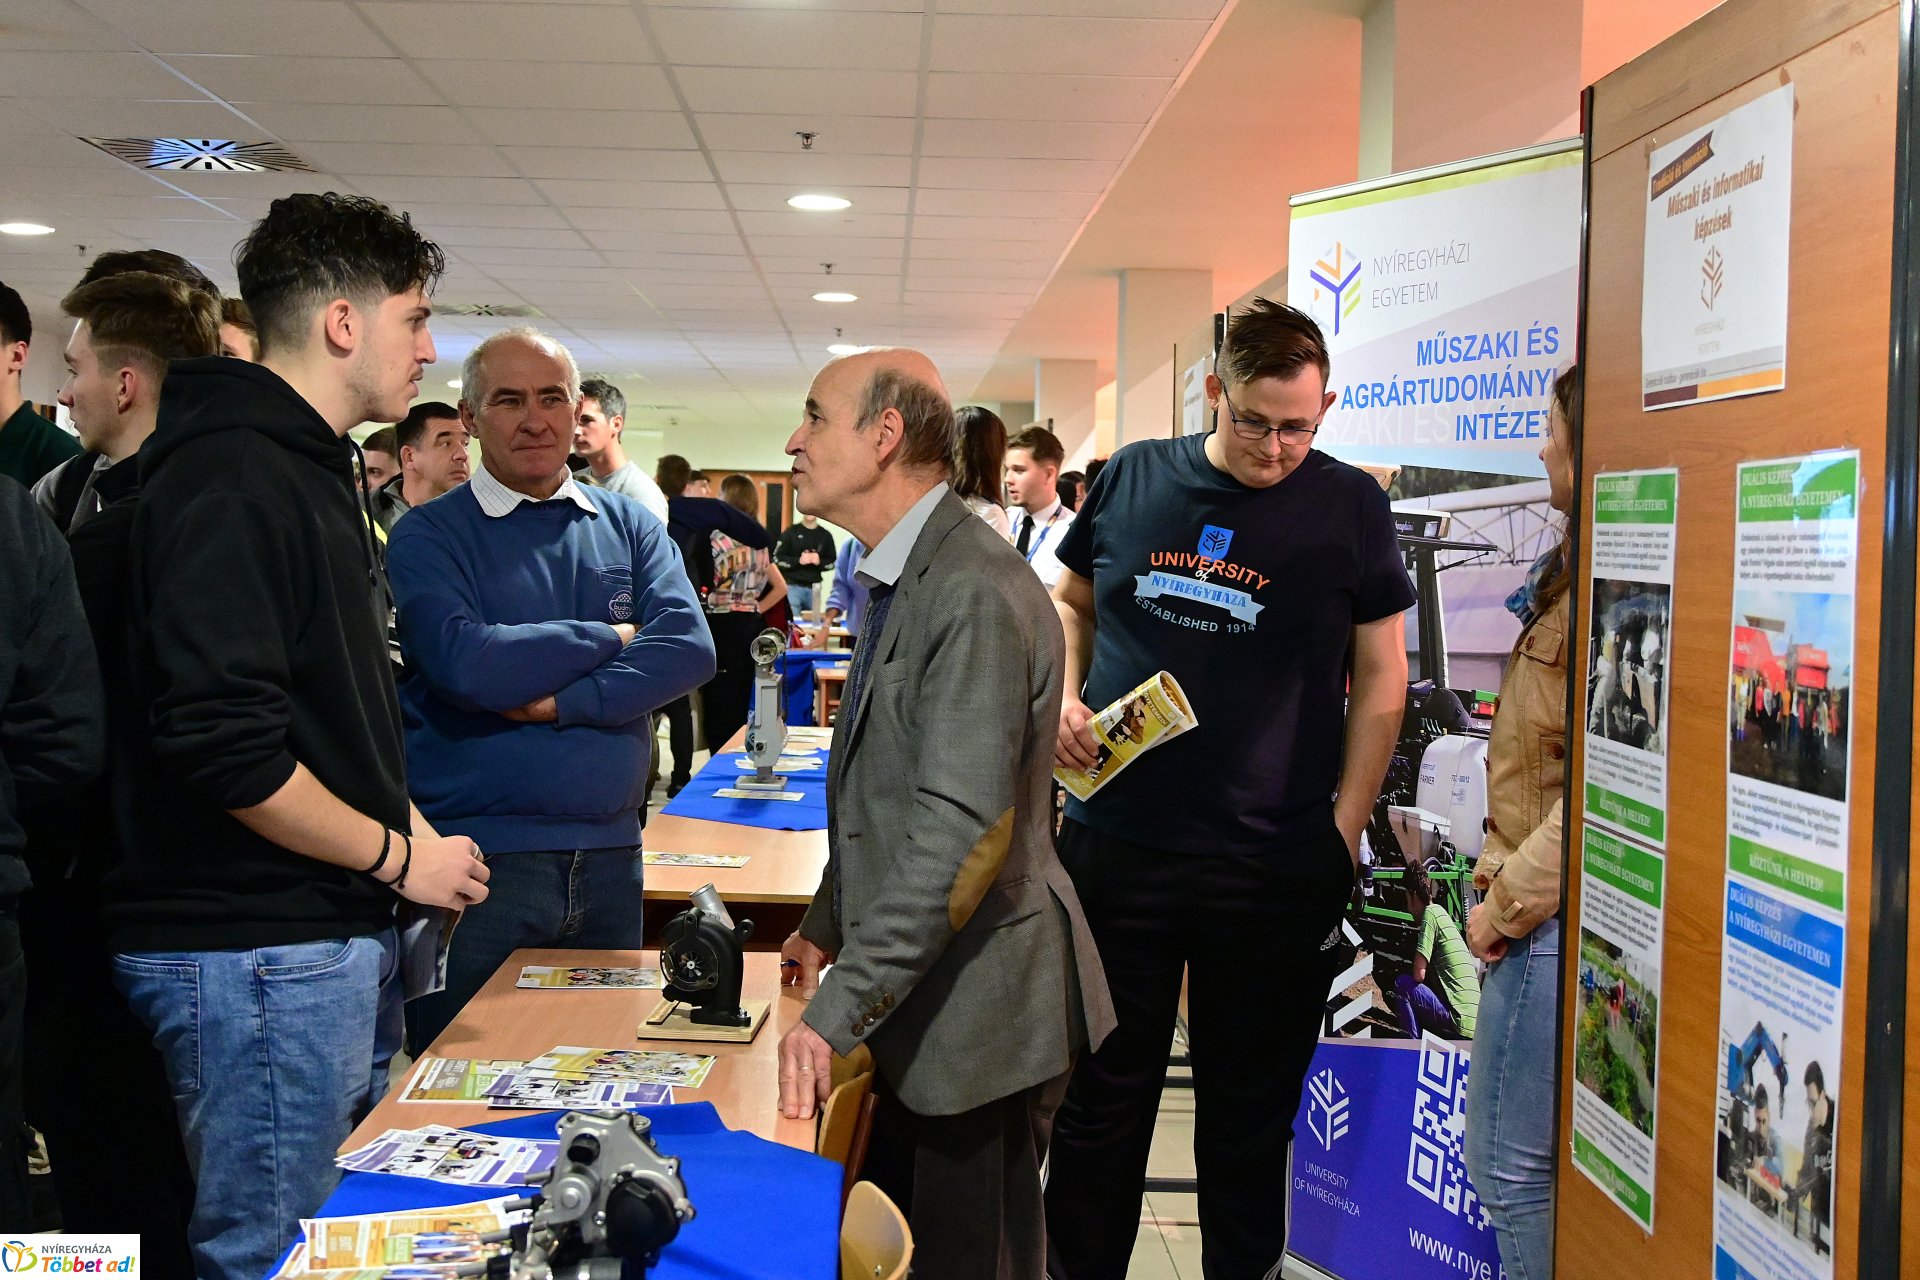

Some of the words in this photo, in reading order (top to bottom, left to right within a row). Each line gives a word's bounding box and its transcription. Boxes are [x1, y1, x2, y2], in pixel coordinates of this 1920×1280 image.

[1701, 180, 1711, 205] és
[1712, 155, 1765, 200] informatikai
[1373, 239, 1470, 277] NYÍREGYHÁZI
[1372, 281, 1438, 309] EGYETEM
[1416, 330, 1518, 367] MŰSZAKI
[1527, 320, 1560, 357] ÉS
[1151, 551, 1271, 590] UNIVERSITY
[1195, 566, 1214, 582] of
[1135, 595, 1218, 632] ESTABLISHED
[1226, 623, 1256, 633] 1914
[1305, 1160, 1349, 1190] UNIVERSITY
[1294, 1177, 1306, 1190] OF
[1306, 1182, 1361, 1217] NYÍREGYHÁZA
